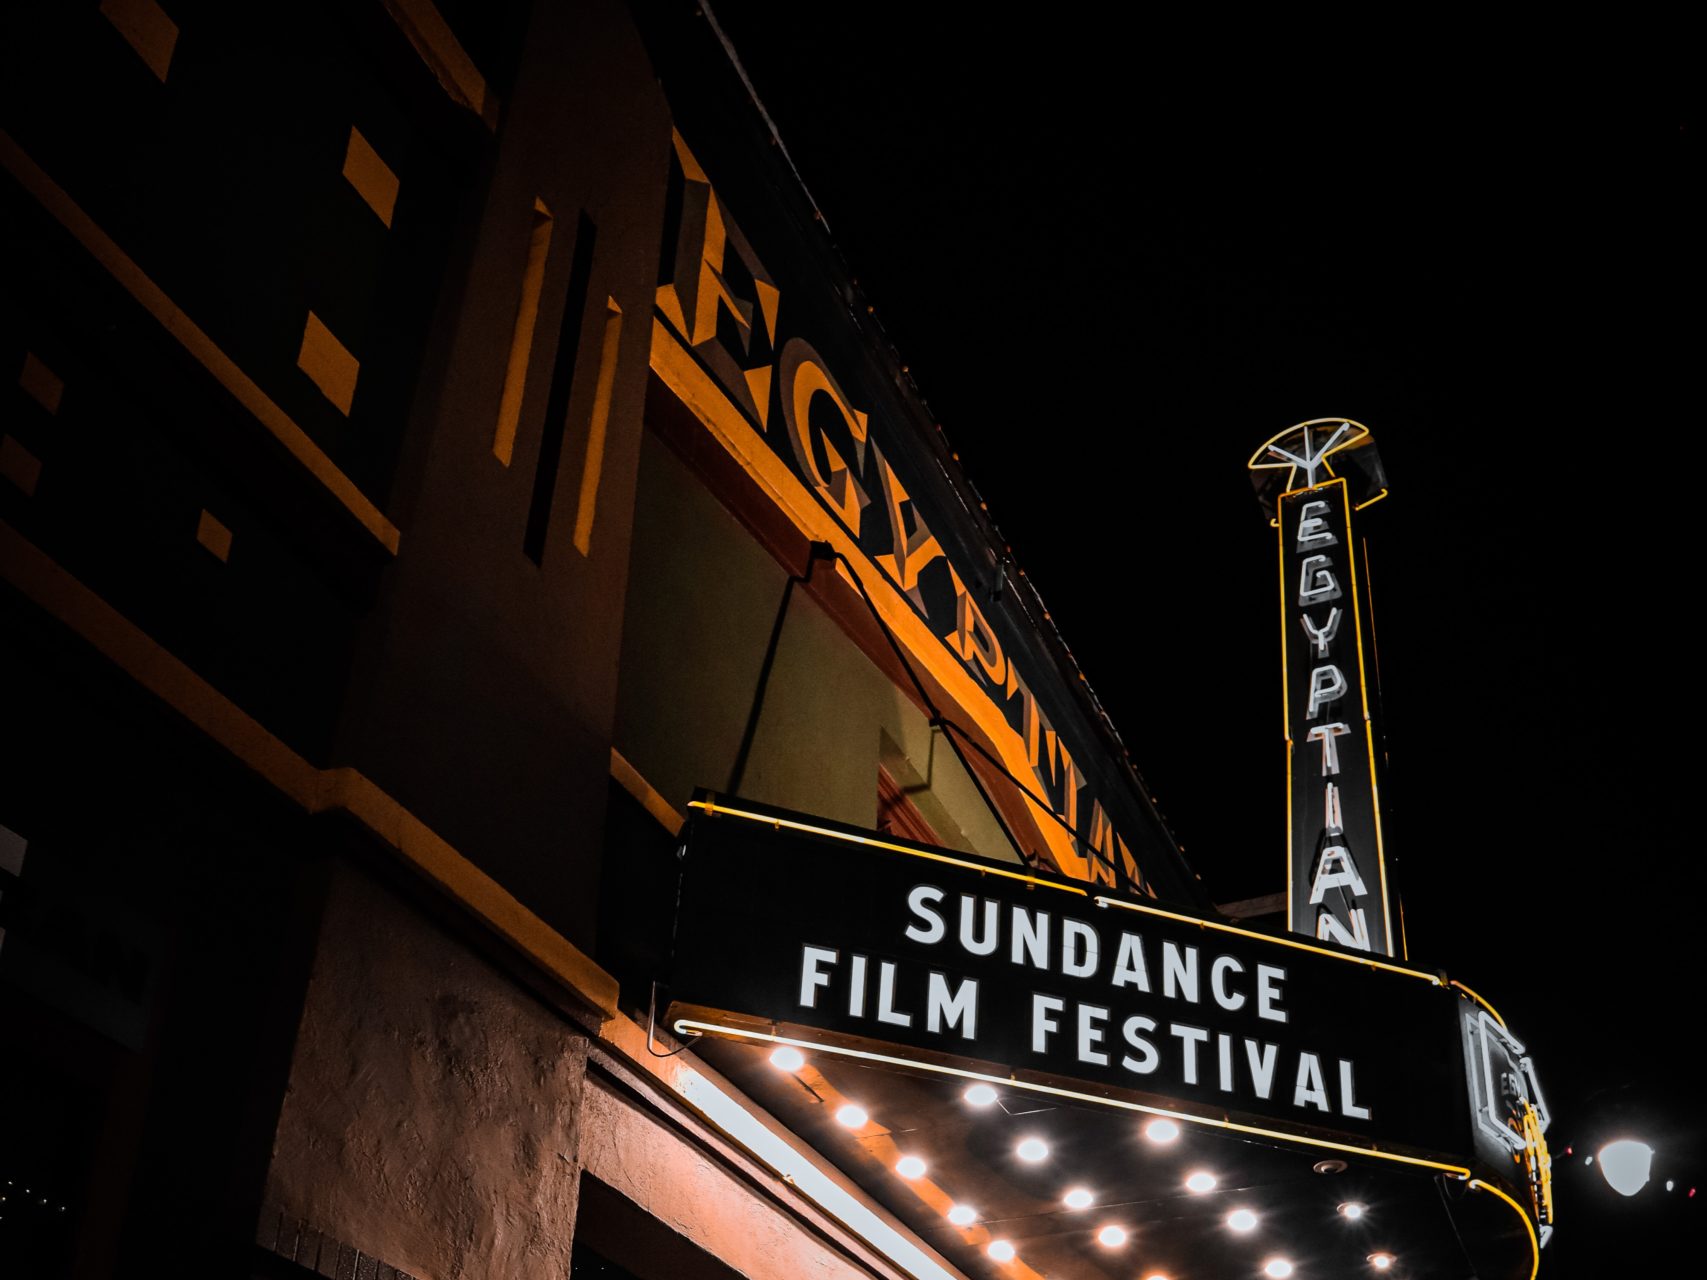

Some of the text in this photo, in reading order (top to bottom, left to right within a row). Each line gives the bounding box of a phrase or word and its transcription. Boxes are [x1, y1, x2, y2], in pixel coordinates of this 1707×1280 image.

[800, 945, 1373, 1121] FILM FESTIVAL
[904, 885, 1289, 1025] SUNDANCE
